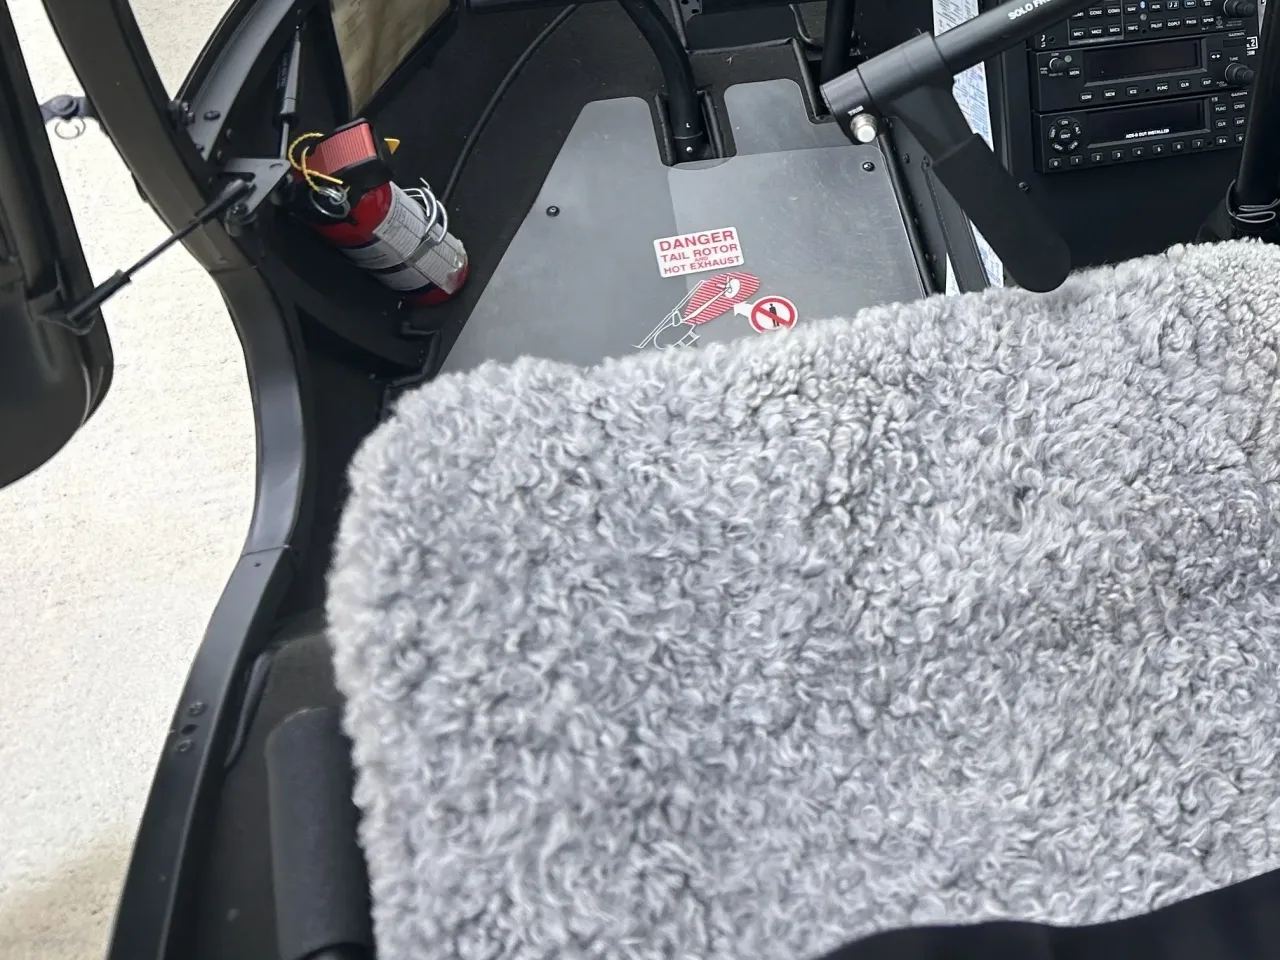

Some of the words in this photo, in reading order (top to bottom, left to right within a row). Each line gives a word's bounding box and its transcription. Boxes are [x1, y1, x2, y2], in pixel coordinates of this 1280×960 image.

[1008, 2, 1034, 20] SOLO
[659, 230, 735, 252] DANGER
[661, 252, 690, 263] TAIL
[693, 243, 738, 258] ROTOR
[664, 264, 687, 275] HOT
[690, 255, 741, 271] EXHAUST
